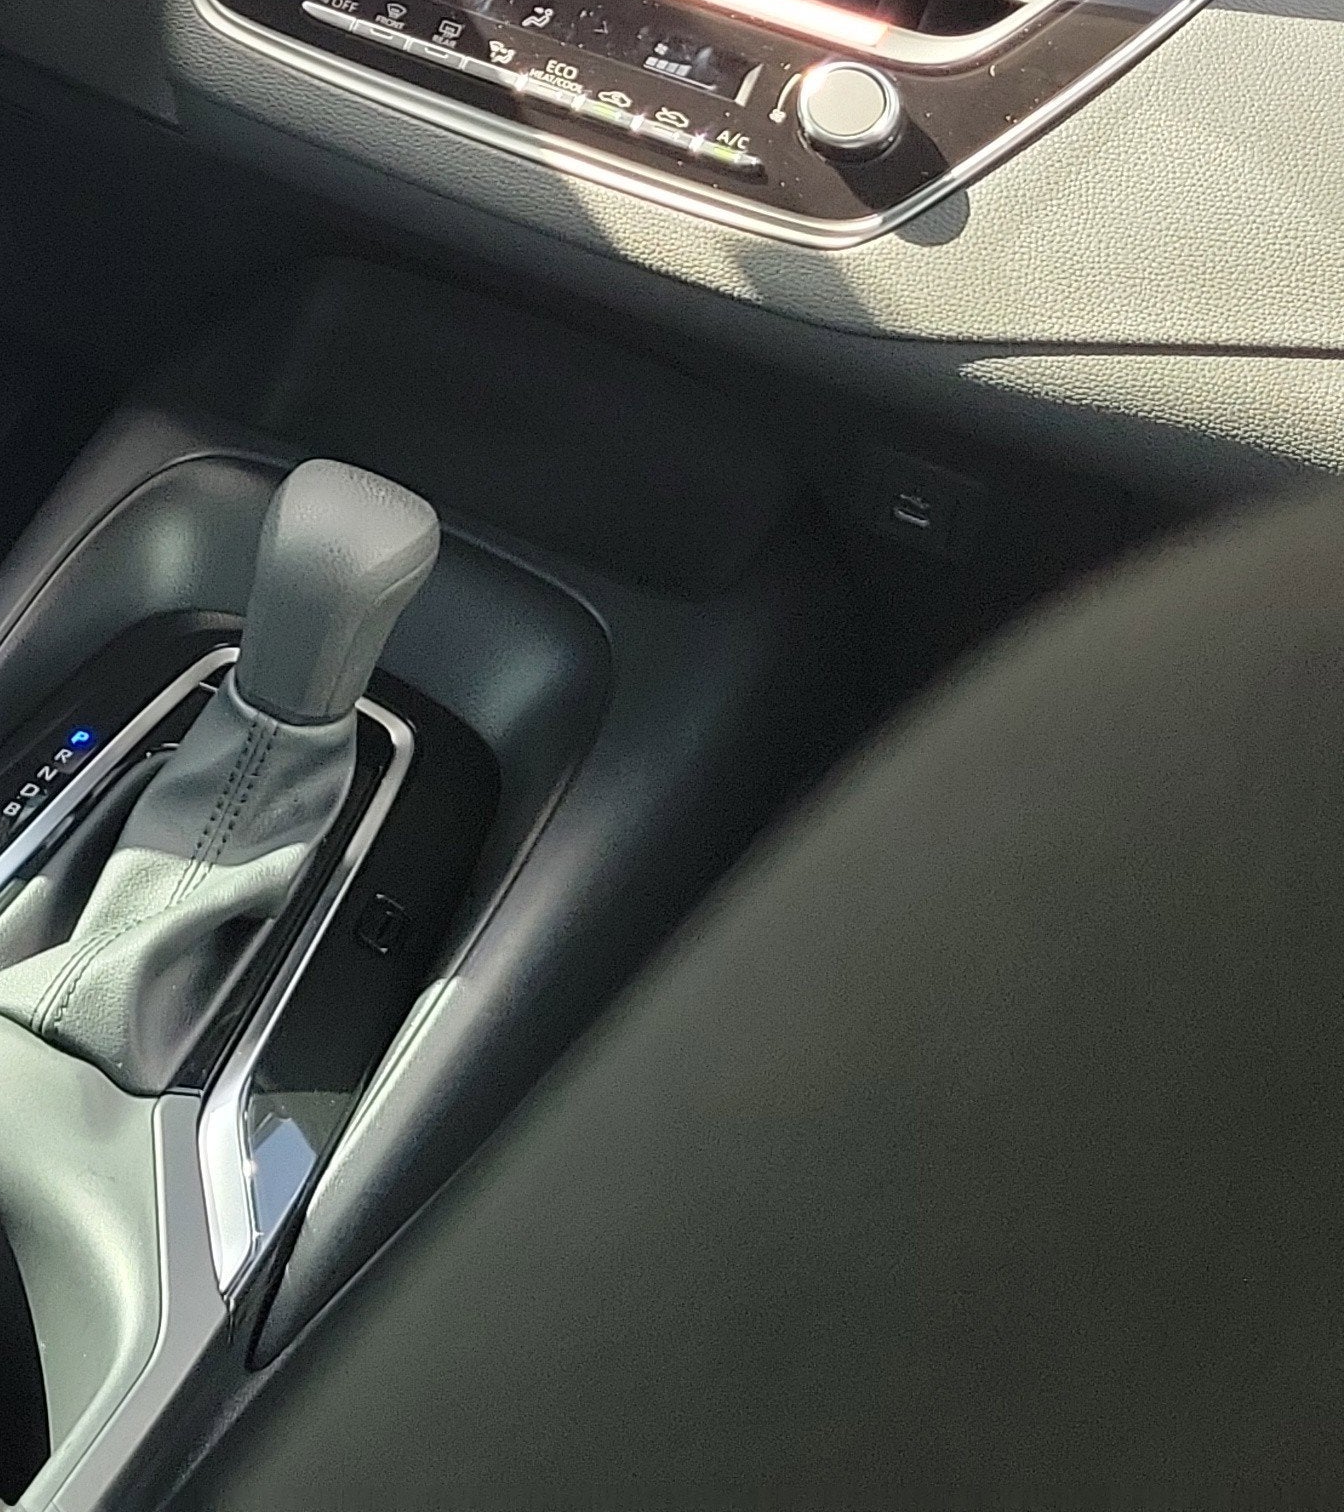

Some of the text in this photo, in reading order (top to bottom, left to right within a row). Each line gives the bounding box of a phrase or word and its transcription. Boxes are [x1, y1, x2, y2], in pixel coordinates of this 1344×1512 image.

[375, 15, 405, 30] FRONT
[546, 59, 578, 80] ECO
[529, 68, 583, 93] HEAT/COOL
[716, 130, 750, 150] A/C
[3, 731, 90, 817] P R N D B
